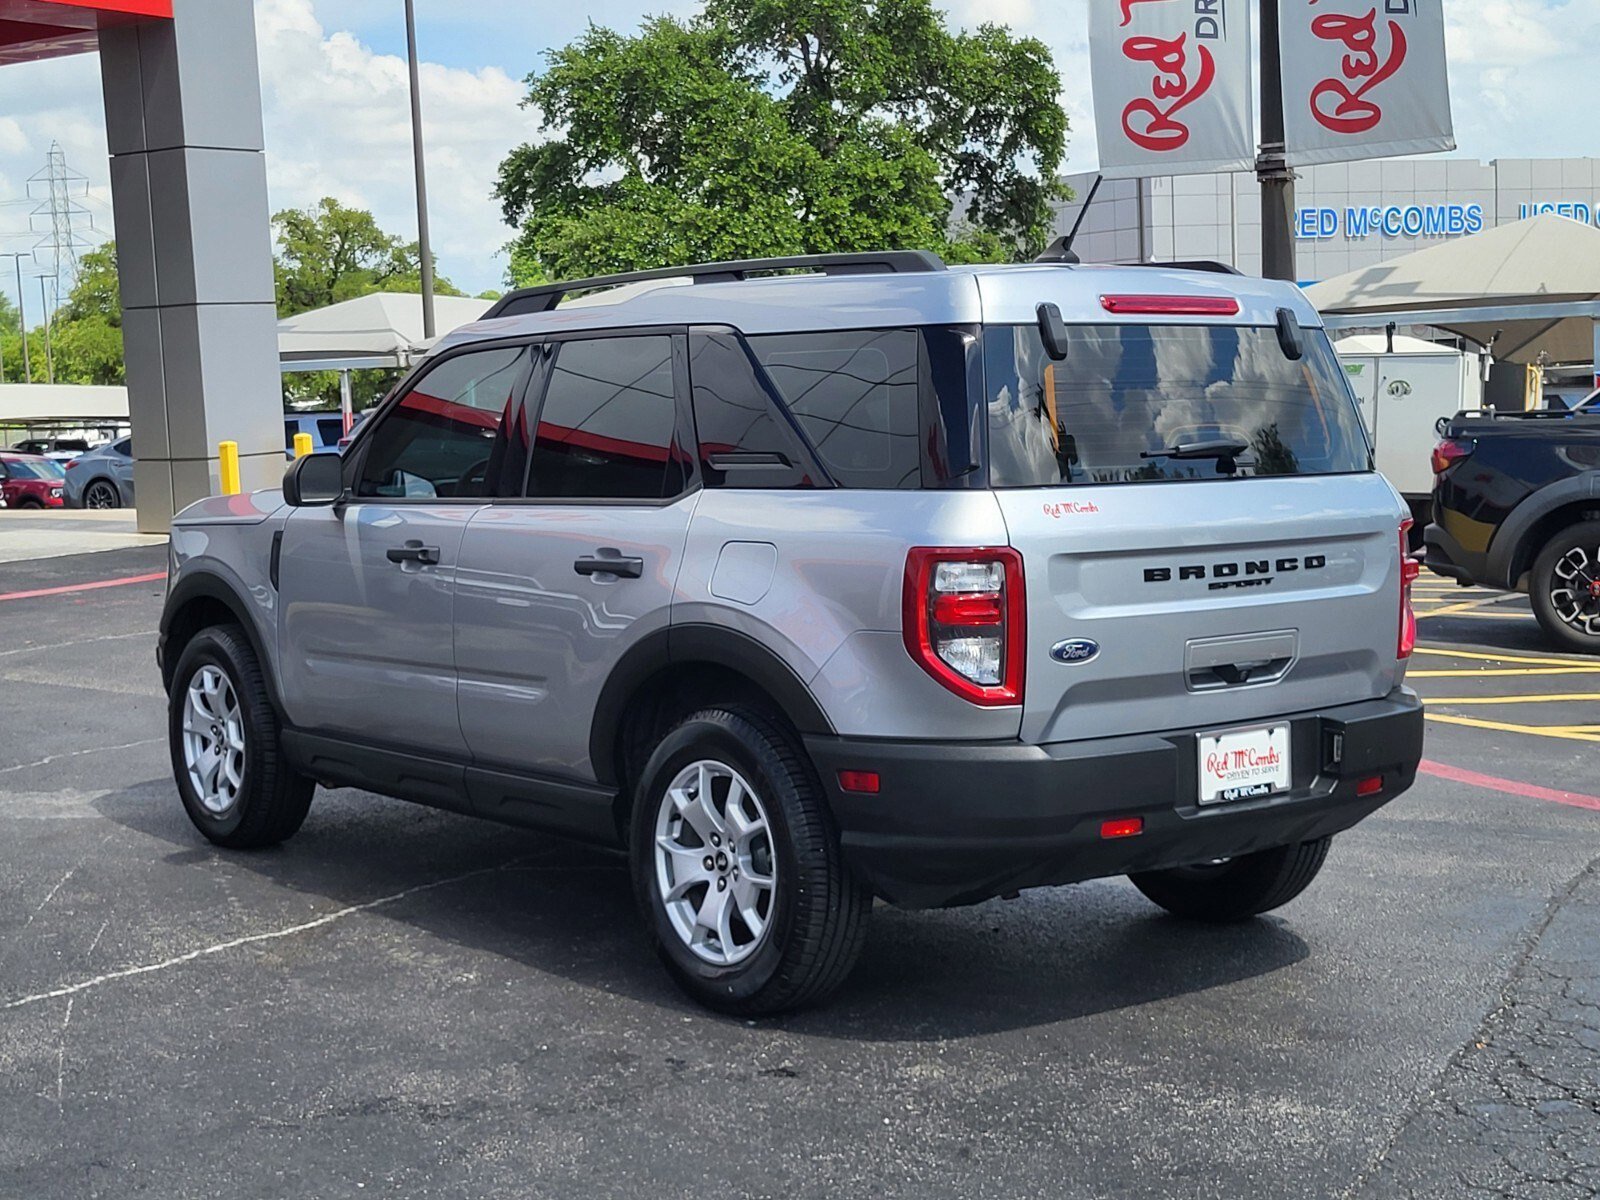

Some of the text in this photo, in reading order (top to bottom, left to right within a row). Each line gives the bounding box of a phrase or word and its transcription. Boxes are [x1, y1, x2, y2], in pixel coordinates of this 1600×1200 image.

[1310, 7, 1407, 133] Red
[1121, 31, 1215, 151] Red
[1294, 205, 1482, 236] ED McCOMBS
[1043, 503, 1060, 518] Red
[1144, 555, 1326, 582] BRONCO
[1208, 577, 1274, 590] SPORT
[1063, 644, 1089, 658] Ford
[1207, 745, 1279, 778] Red McCombs
[1227, 765, 1279, 780] DRIVEN TO SERVE
